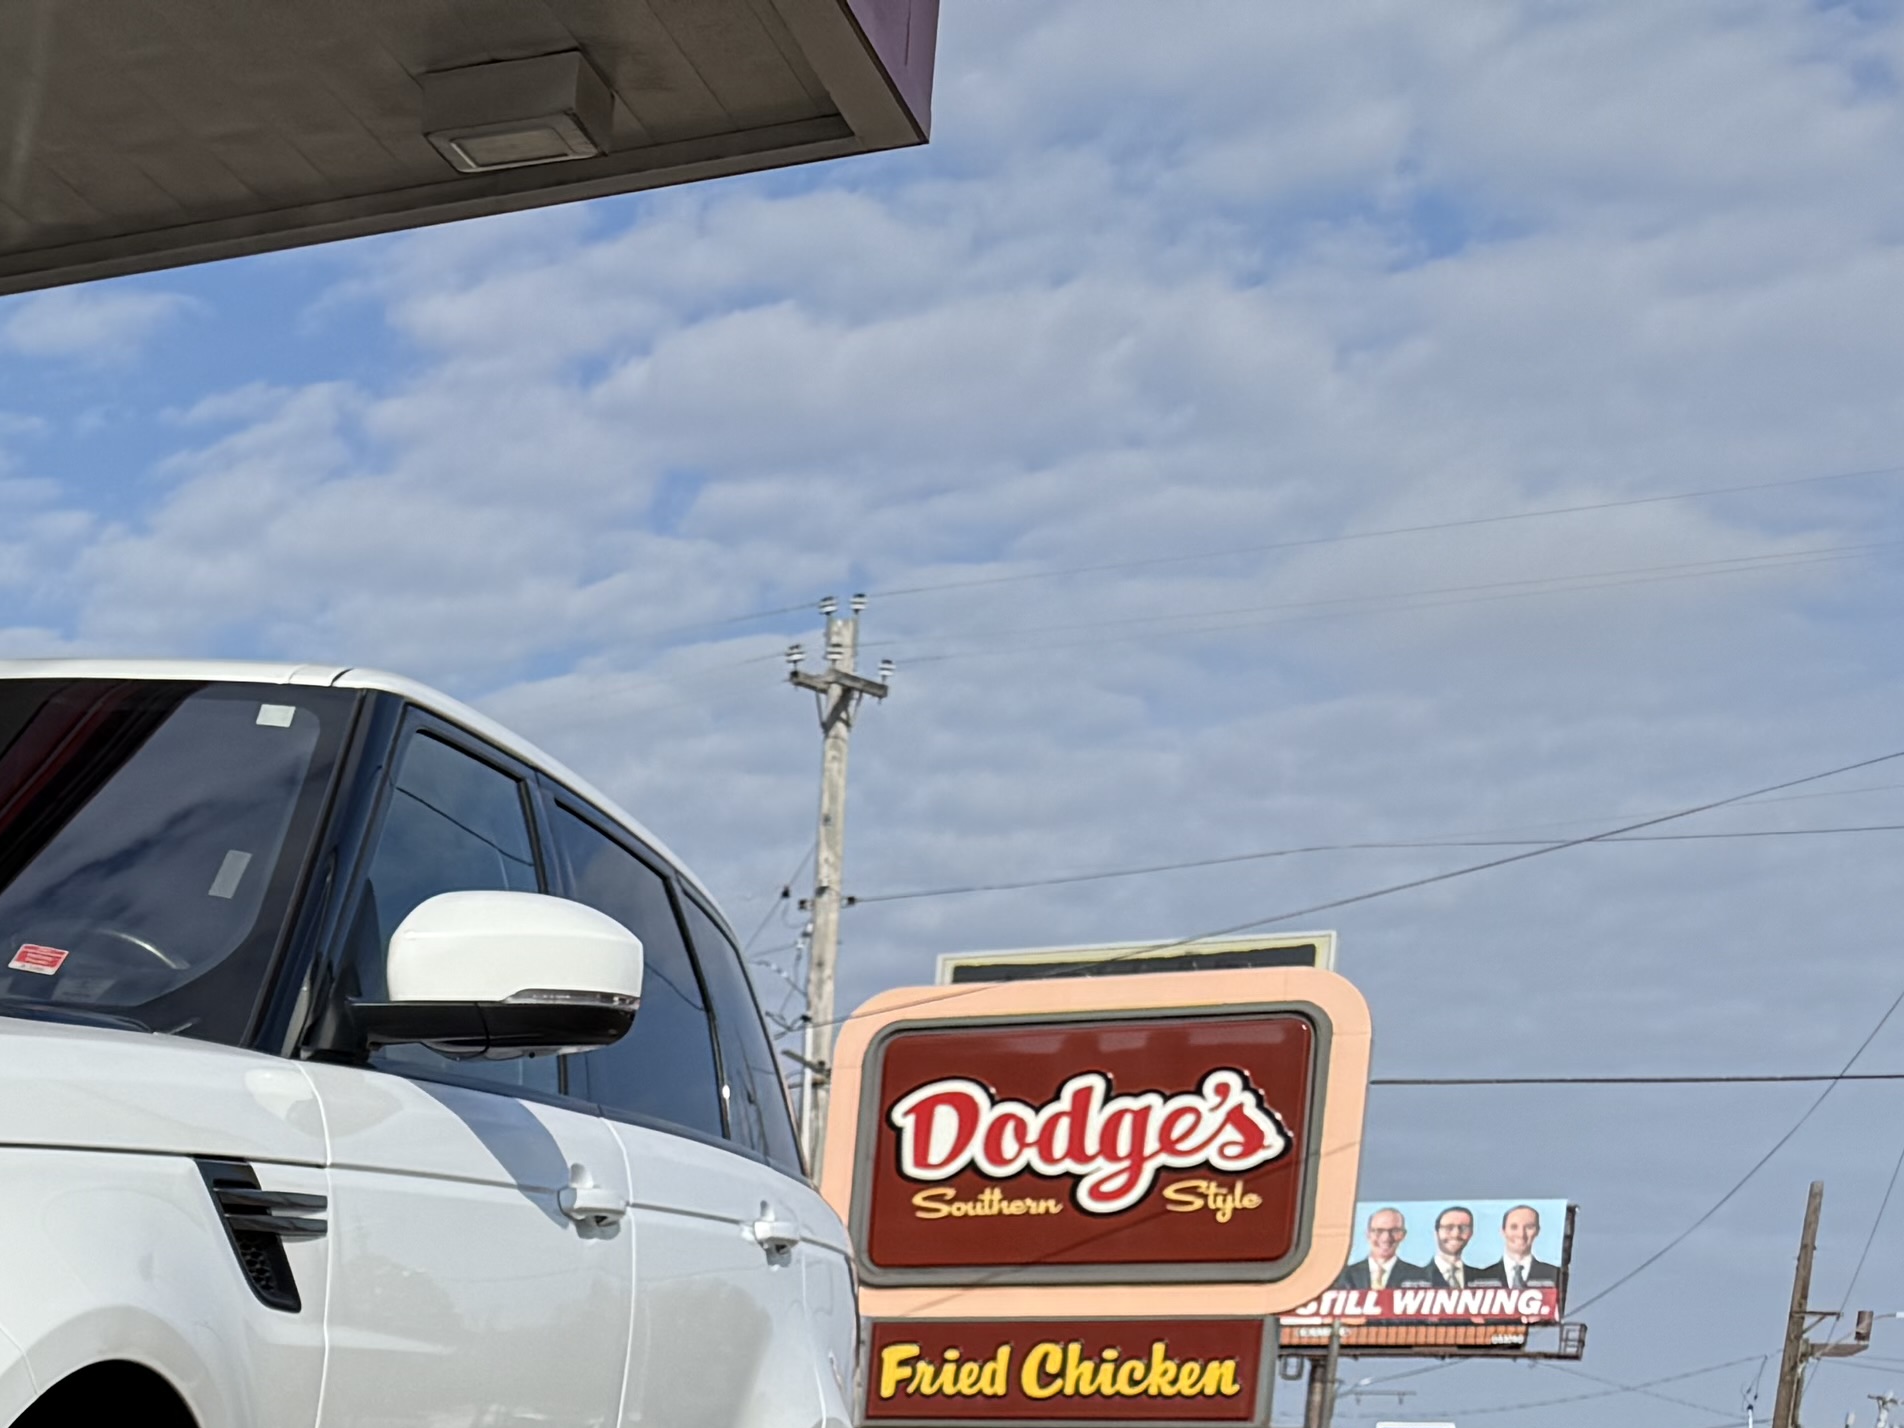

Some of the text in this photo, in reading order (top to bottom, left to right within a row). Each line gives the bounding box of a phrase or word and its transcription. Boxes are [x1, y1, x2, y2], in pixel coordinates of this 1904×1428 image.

[892, 1069, 1286, 1213] Dodge's
[911, 1180, 1262, 1223] Southern Style
[1393, 1289, 1551, 1315] WINNING.
[880, 1340, 1240, 1399] Fried Chicken
